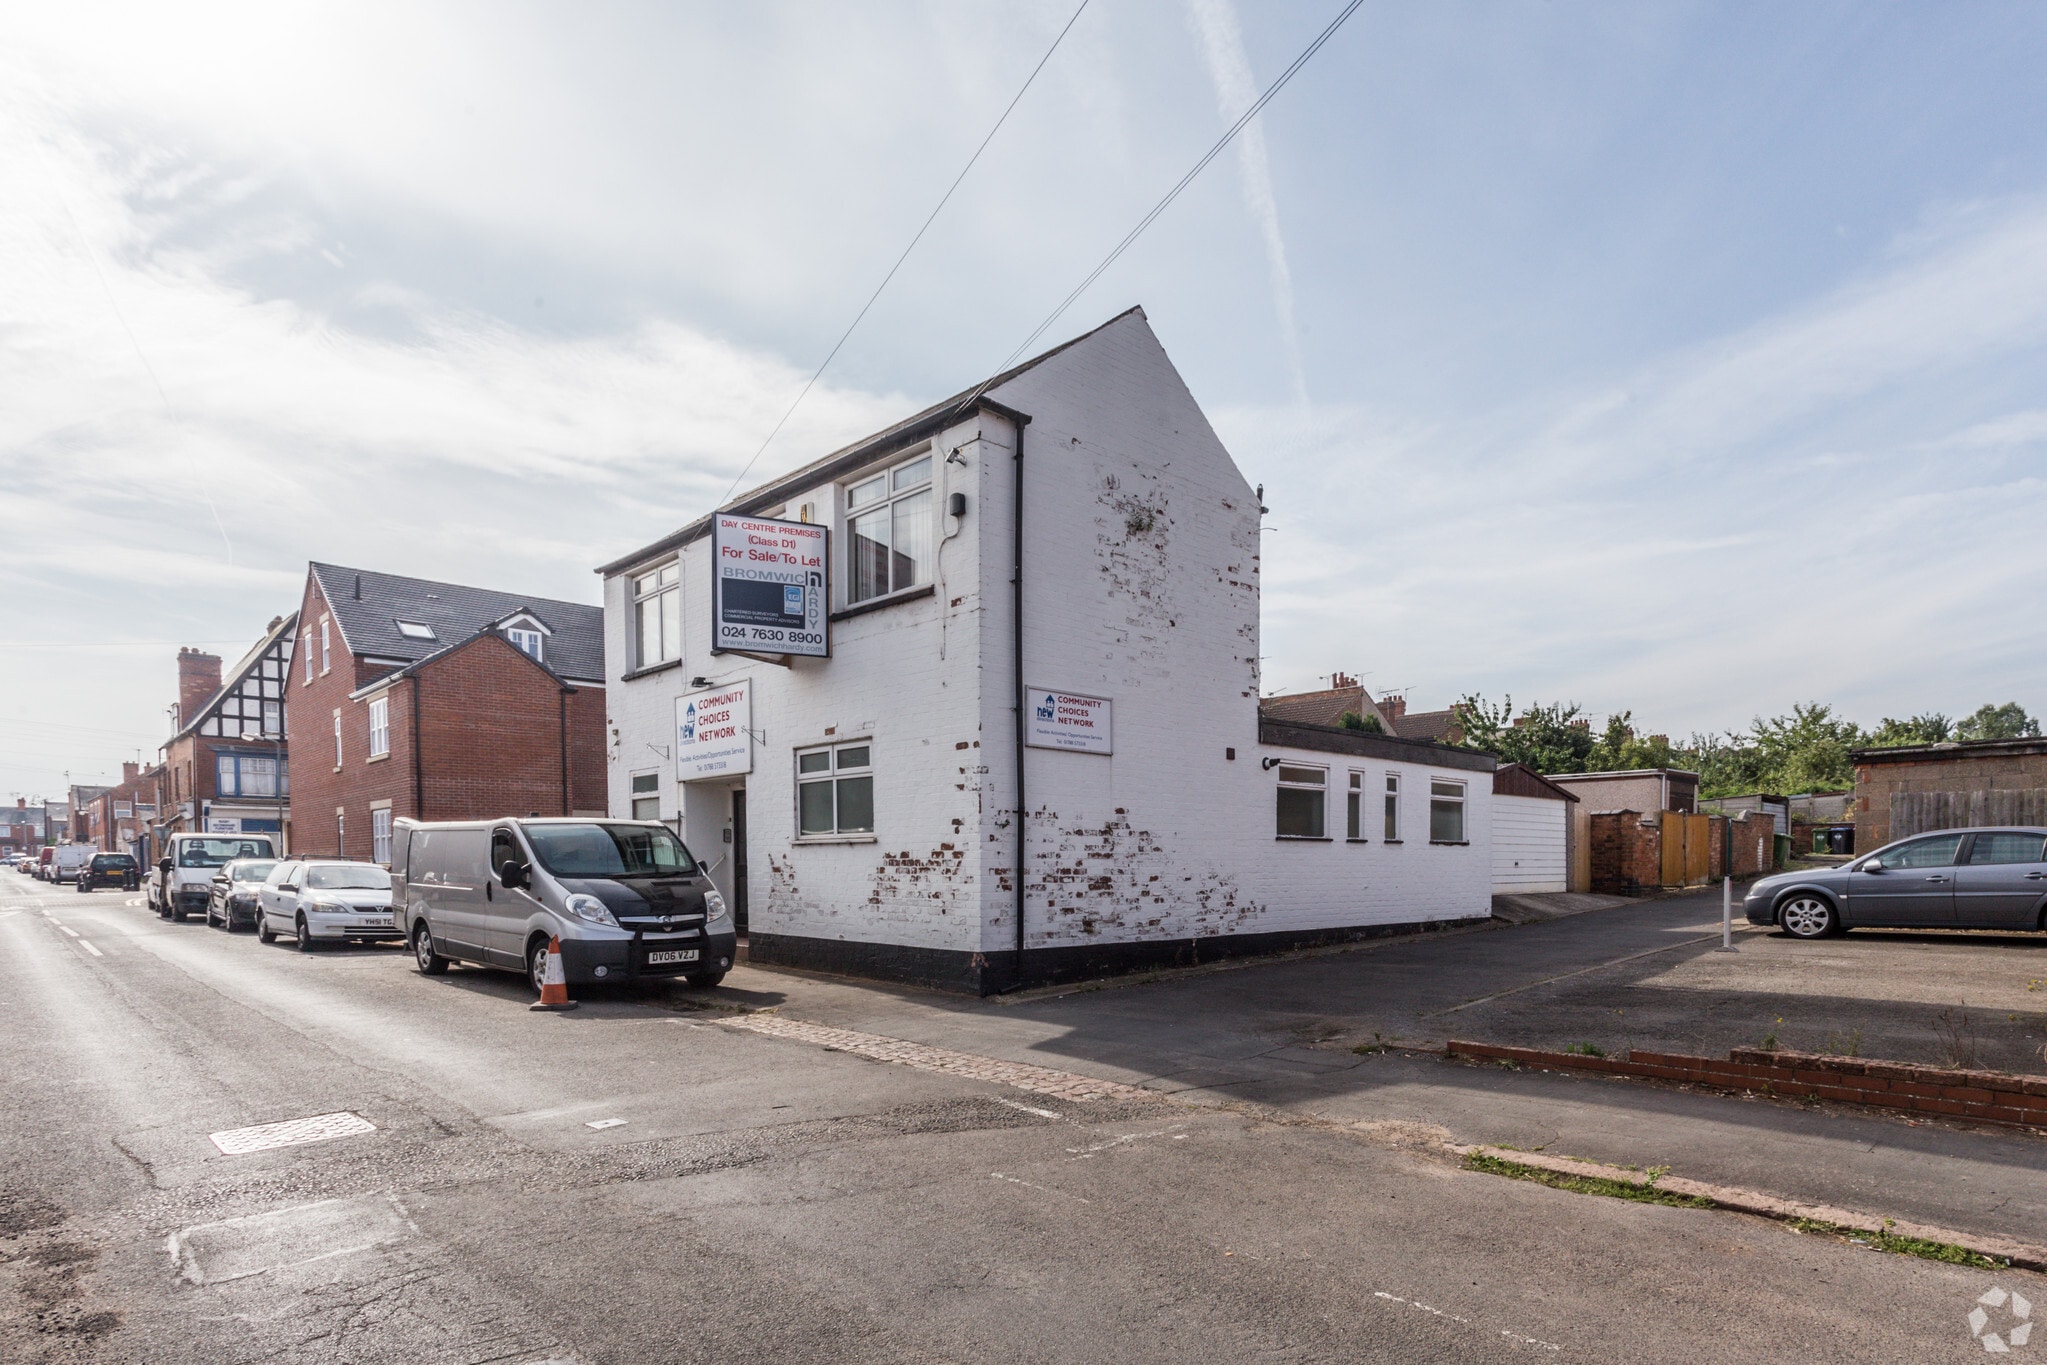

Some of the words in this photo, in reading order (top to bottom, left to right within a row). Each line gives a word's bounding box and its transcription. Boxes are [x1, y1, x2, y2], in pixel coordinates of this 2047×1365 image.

[721, 519, 739, 529] DAY
[741, 522, 776, 533] CENTRE
[779, 526, 821, 539] PREMISES
[748, 534, 778, 547] (Class
[781, 539, 796, 550] D1)
[722, 546, 743, 558] For
[748, 549, 797, 565] Sale/To
[801, 555, 821, 567] Let
[721, 626, 746, 638] 024
[751, 628, 784, 641] 7630
[788, 631, 822, 644] 8900
[722, 639, 822, 653] www.bromwichhardy.com
[698, 690, 744, 710] COMMUNITY
[1058, 696, 1102, 708] COMMUNITY
[698, 710, 730, 726] CHOICES
[1058, 706, 1089, 717] CHOICES
[1058, 717, 1094, 728] NETWORK
[698, 726, 736, 742] NETWORK
[652, 951, 676, 962] DV06
[679, 950, 695, 961] VZJ
